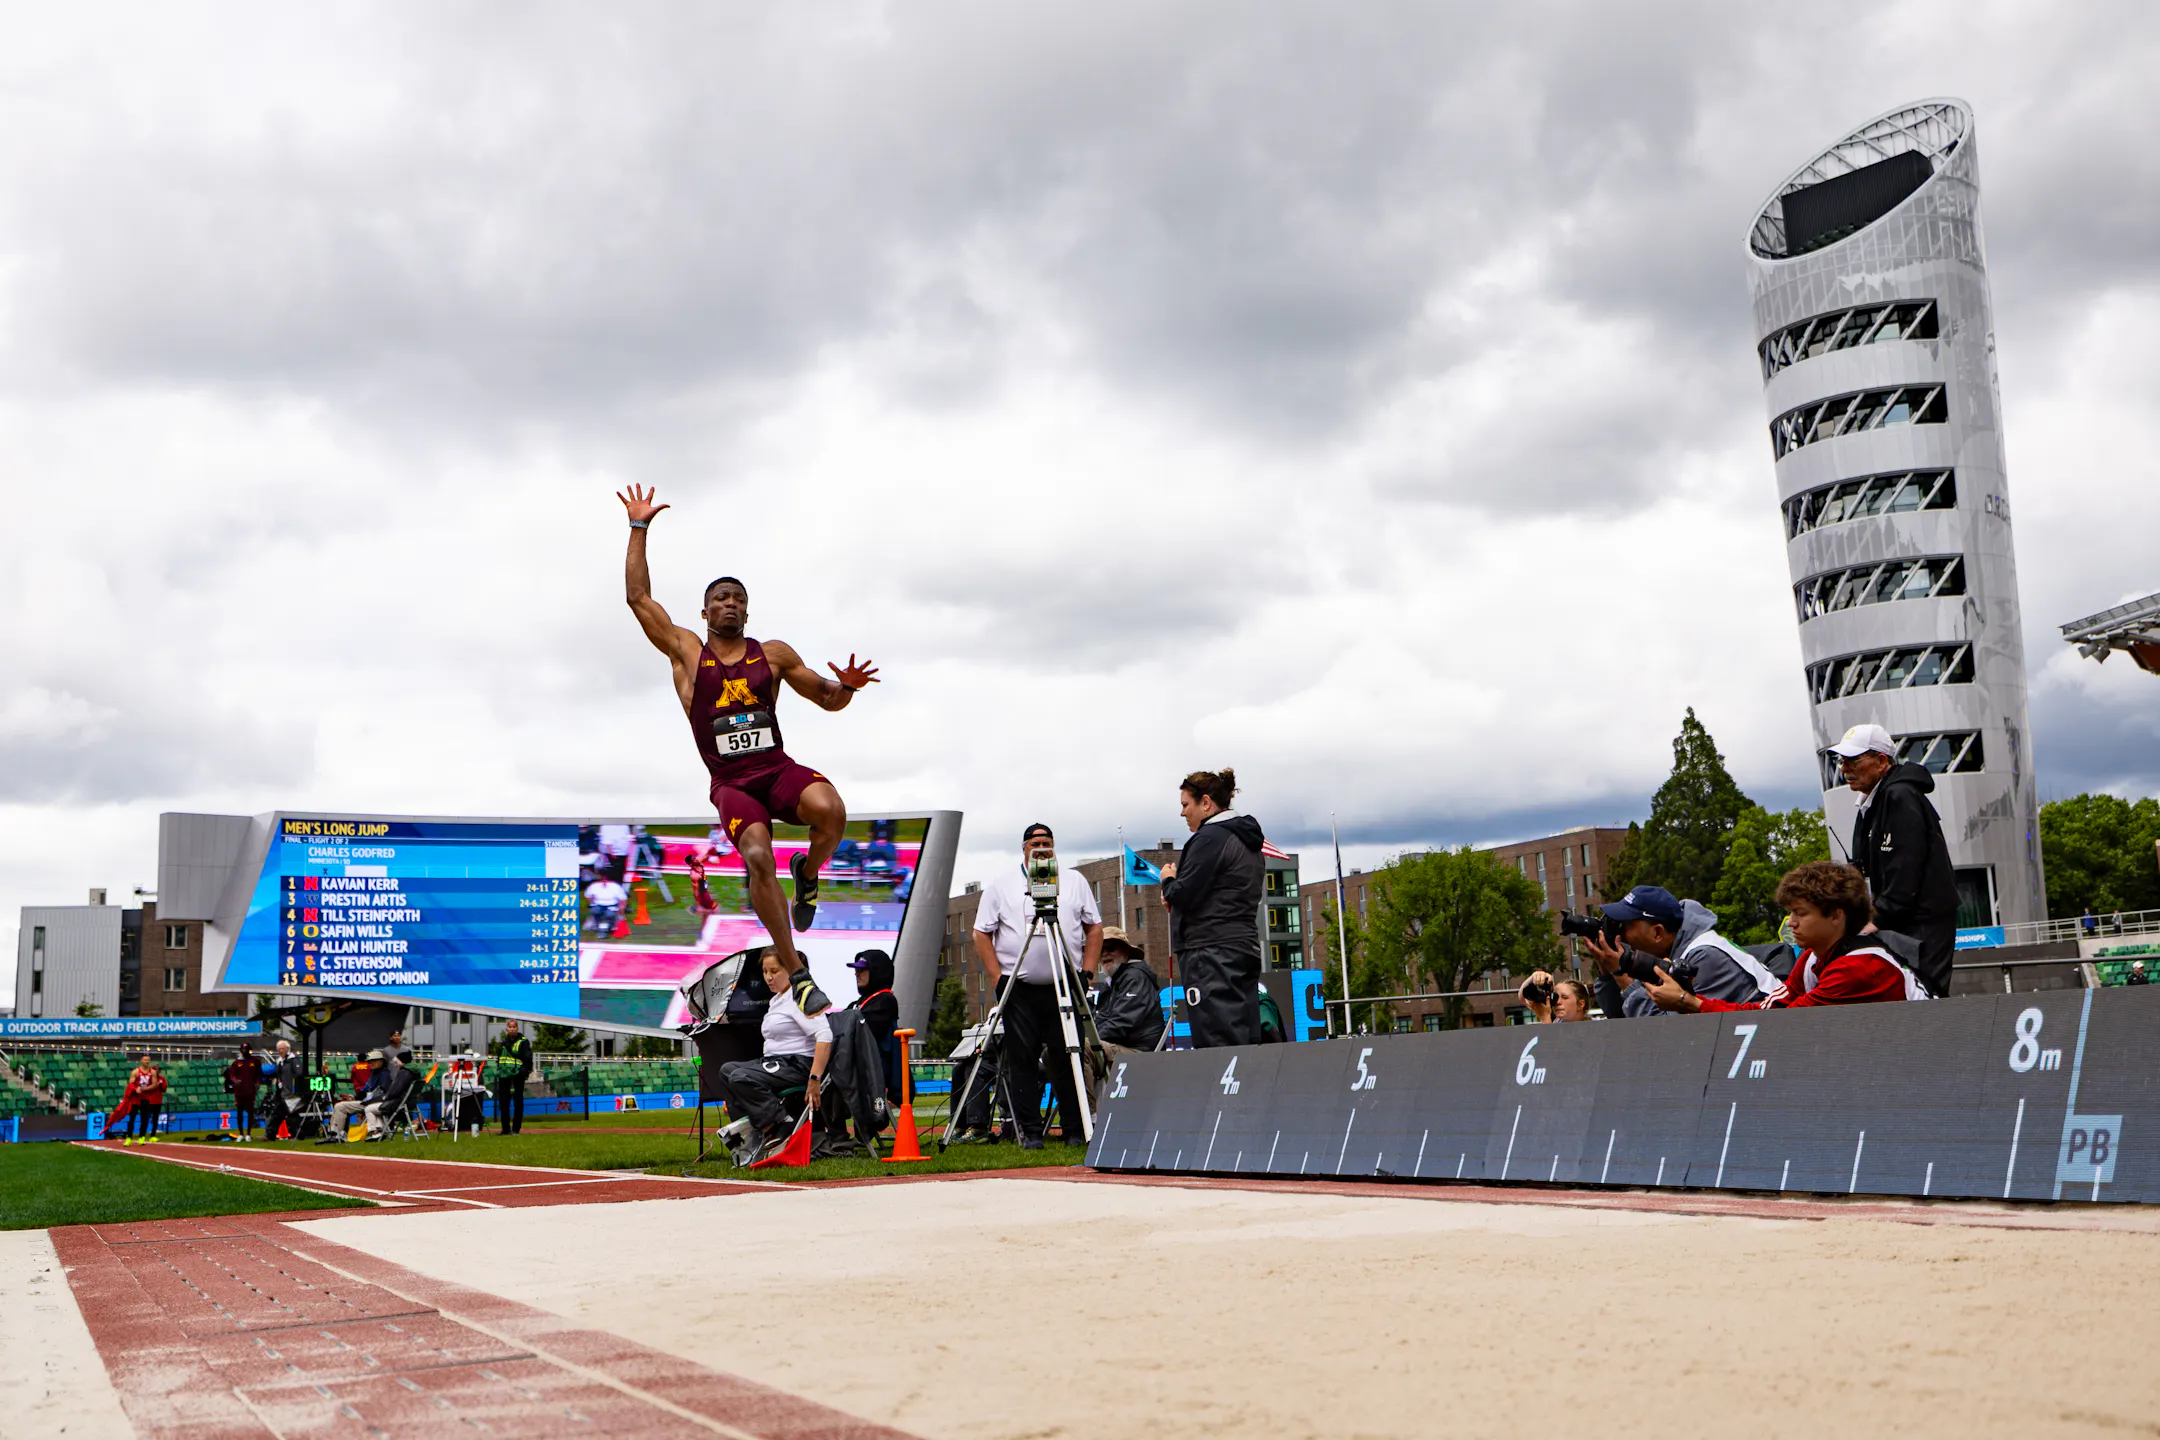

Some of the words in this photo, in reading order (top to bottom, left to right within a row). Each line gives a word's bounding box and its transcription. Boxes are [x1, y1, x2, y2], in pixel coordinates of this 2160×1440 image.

[728, 730, 760, 751] 597
[285, 821, 321, 835] MEN'S
[323, 822, 355, 836] LONG
[357, 823, 389, 836] JUMP
[284, 836, 302, 844] FINAL
[308, 846, 350, 857] CHARLES
[351, 847, 396, 858] GODFRED
[288, 877, 296, 890] 1
[321, 878, 366, 891] KAVIAN
[367, 878, 399, 891] KERR
[551, 879, 577, 892] 7.59
[288, 892, 296, 906] 3
[321, 893, 371, 907] PRESTIN
[372, 893, 407, 907] ARTIS
[551, 894, 577, 907] 7.47
[287, 908, 296, 922] 4
[320, 909, 347, 922] TILL
[348, 909, 421, 922] STEINFORTH
[551, 909, 577, 922] 7.44
[286, 924, 296, 938] 6
[320, 924, 355, 938] SAFIN
[356, 924, 393, 938] WILLS
[551, 924, 577, 937] 7.34
[287, 940, 295, 954] 7
[320, 940, 358, 954] ALLAN
[360, 940, 408, 954] HUNTER
[551, 939, 577, 952] 7.34
[286, 956, 295, 970] 8
[320, 956, 331, 970] C.
[333, 956, 403, 970] STEVENSON
[551, 955, 577, 967] 7.32
[282, 972, 298, 986] 13
[320, 972, 377, 986] PRECIOUS
[379, 971, 429, 985] OPINION
[551, 970, 577, 983] 7.21
[7, 1022, 61, 1033] OUTDOOR
[63, 1021, 99, 1033] TRACK
[101, 1021, 124, 1033] AND
[126, 1021, 156, 1033] FIELD
[158, 1019, 247, 1032] CHAMPIONSHIPS
[2008, 1007, 2063, 1073] 8m
[1727, 1024, 1767, 1079] 7m
[1515, 1035, 1547, 1086] 6m
[1219, 1055, 1241, 1095] 4m
[1350, 1047, 1377, 1092] 5m
[1109, 1062, 1129, 1099] 3m
[2066, 1128, 2111, 1165] PB
